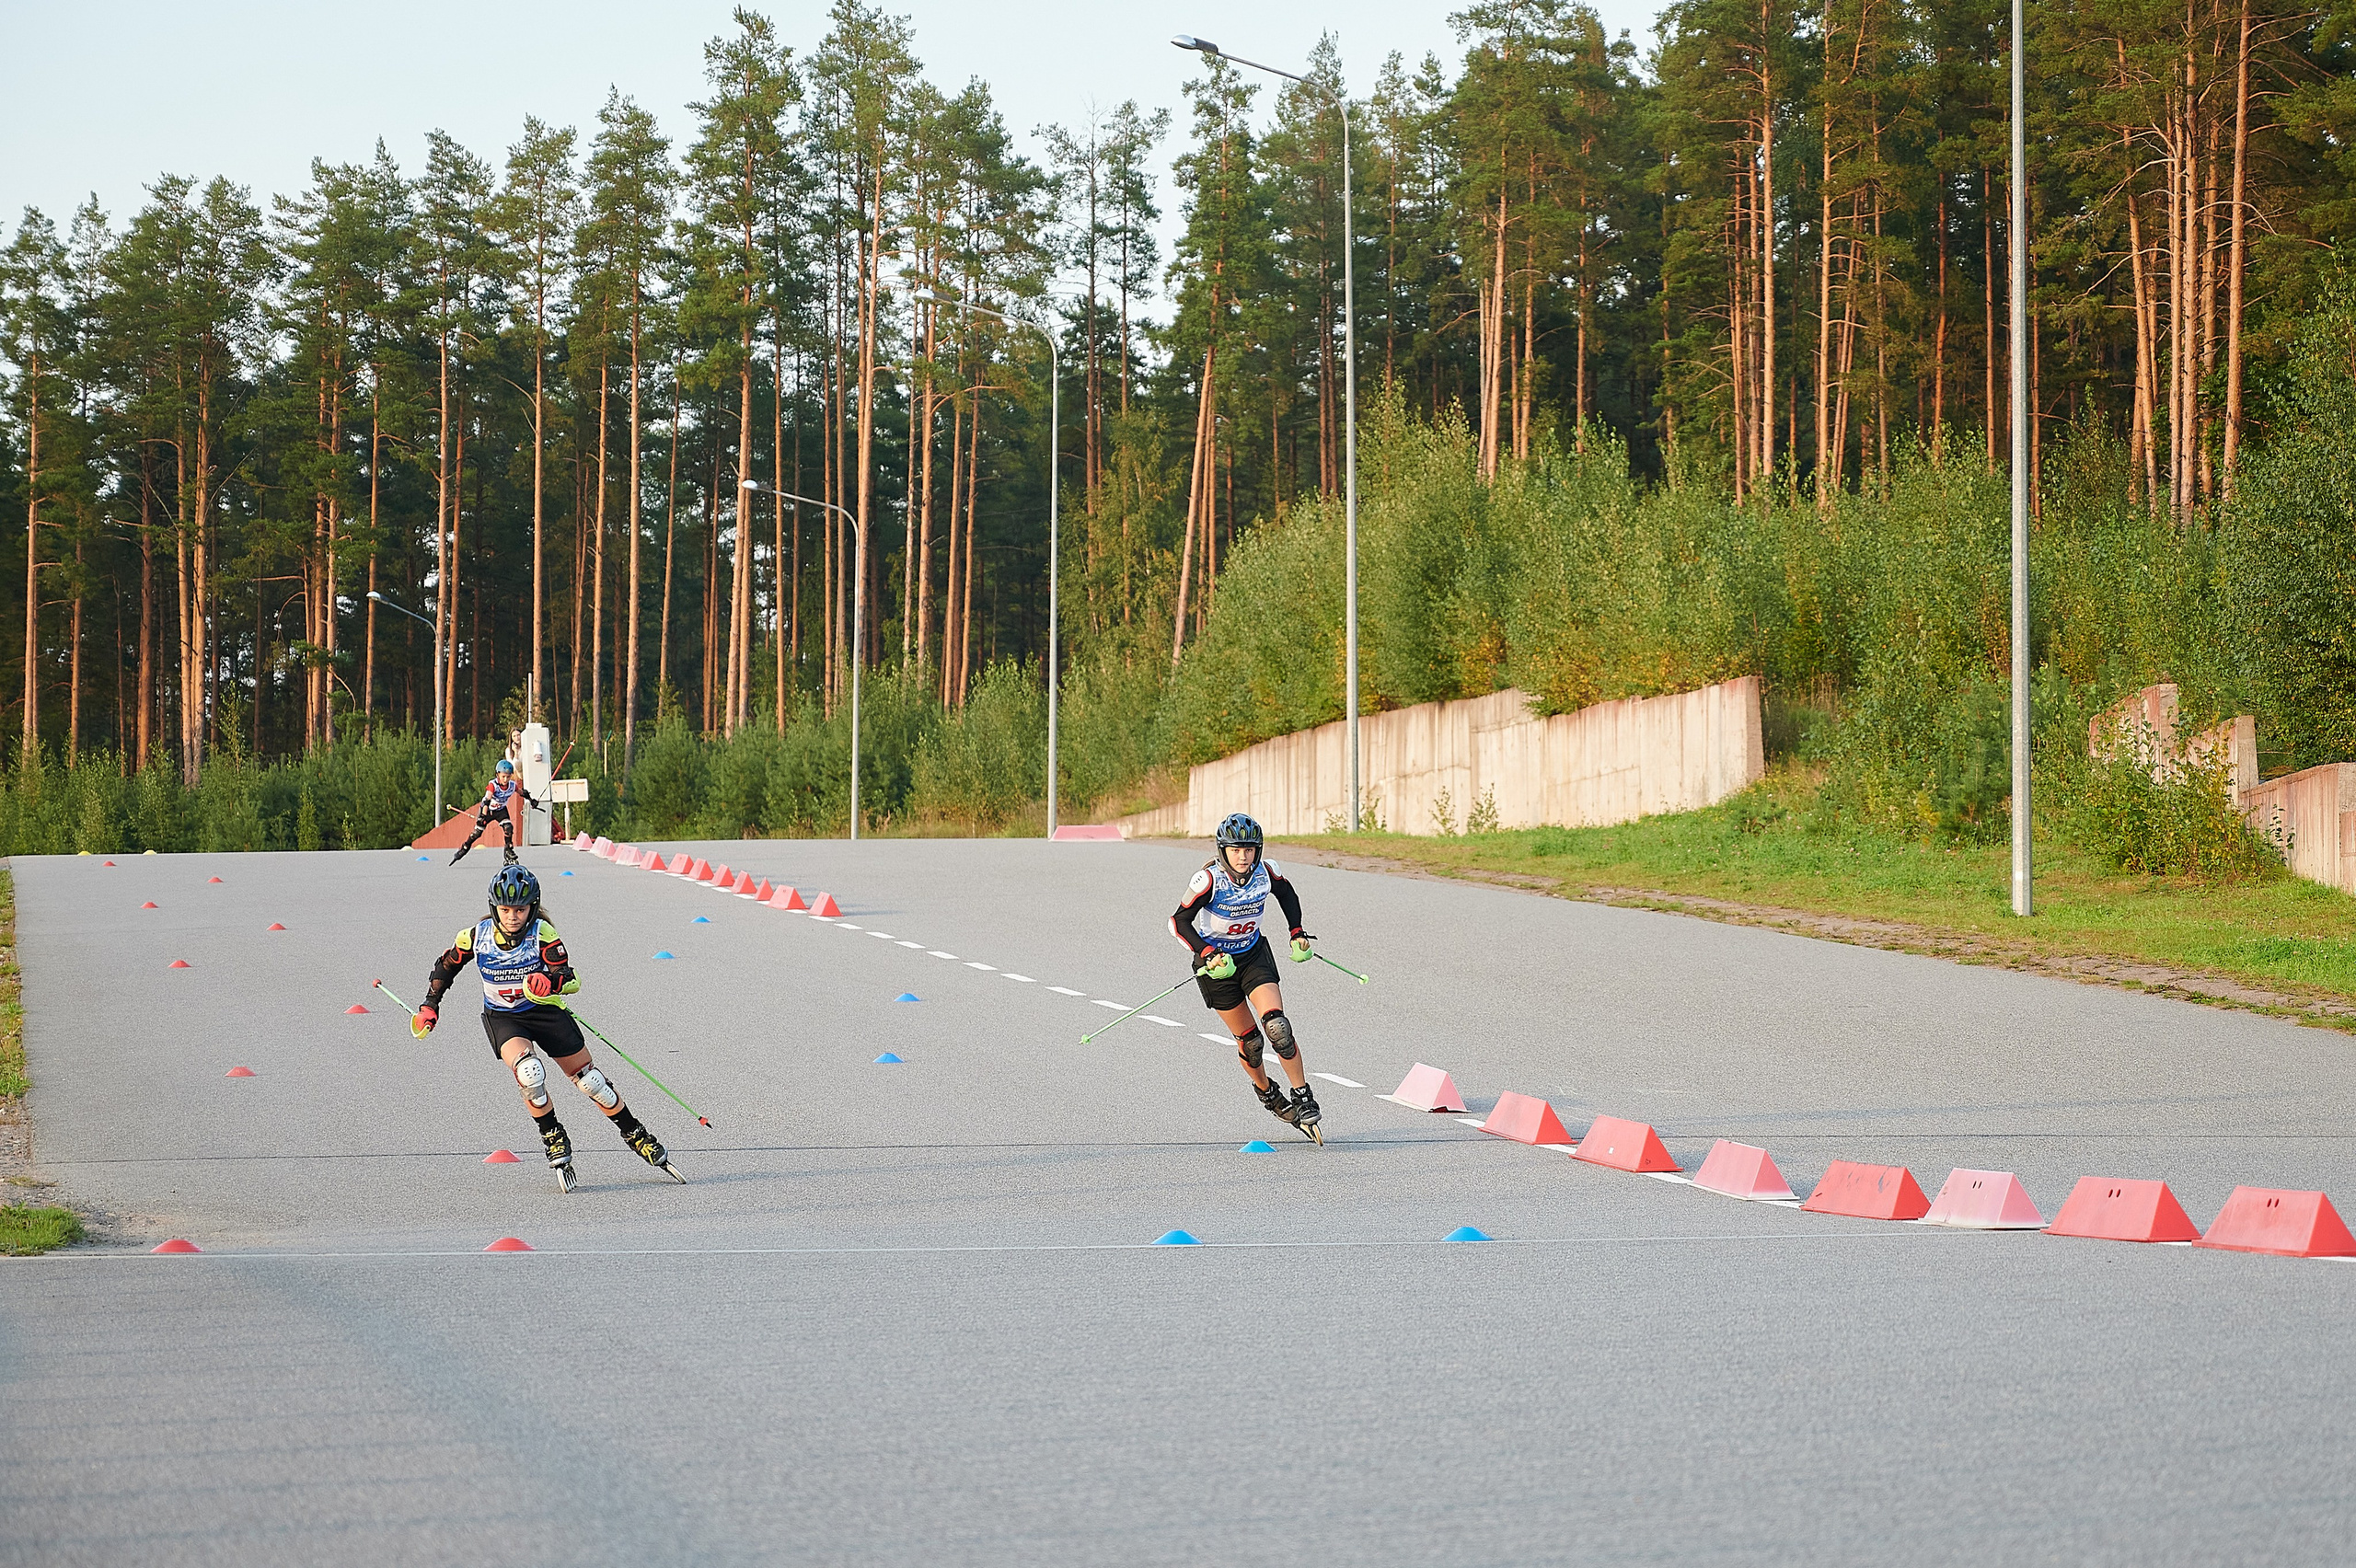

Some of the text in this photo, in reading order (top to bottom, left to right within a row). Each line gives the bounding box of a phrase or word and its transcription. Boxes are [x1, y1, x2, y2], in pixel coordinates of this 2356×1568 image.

[1217, 900, 1265, 912] ЛЕНИНГРАДСК
[1230, 908, 1260, 917] ОБЛАСТЬ
[1226, 921, 1256, 935] 86
